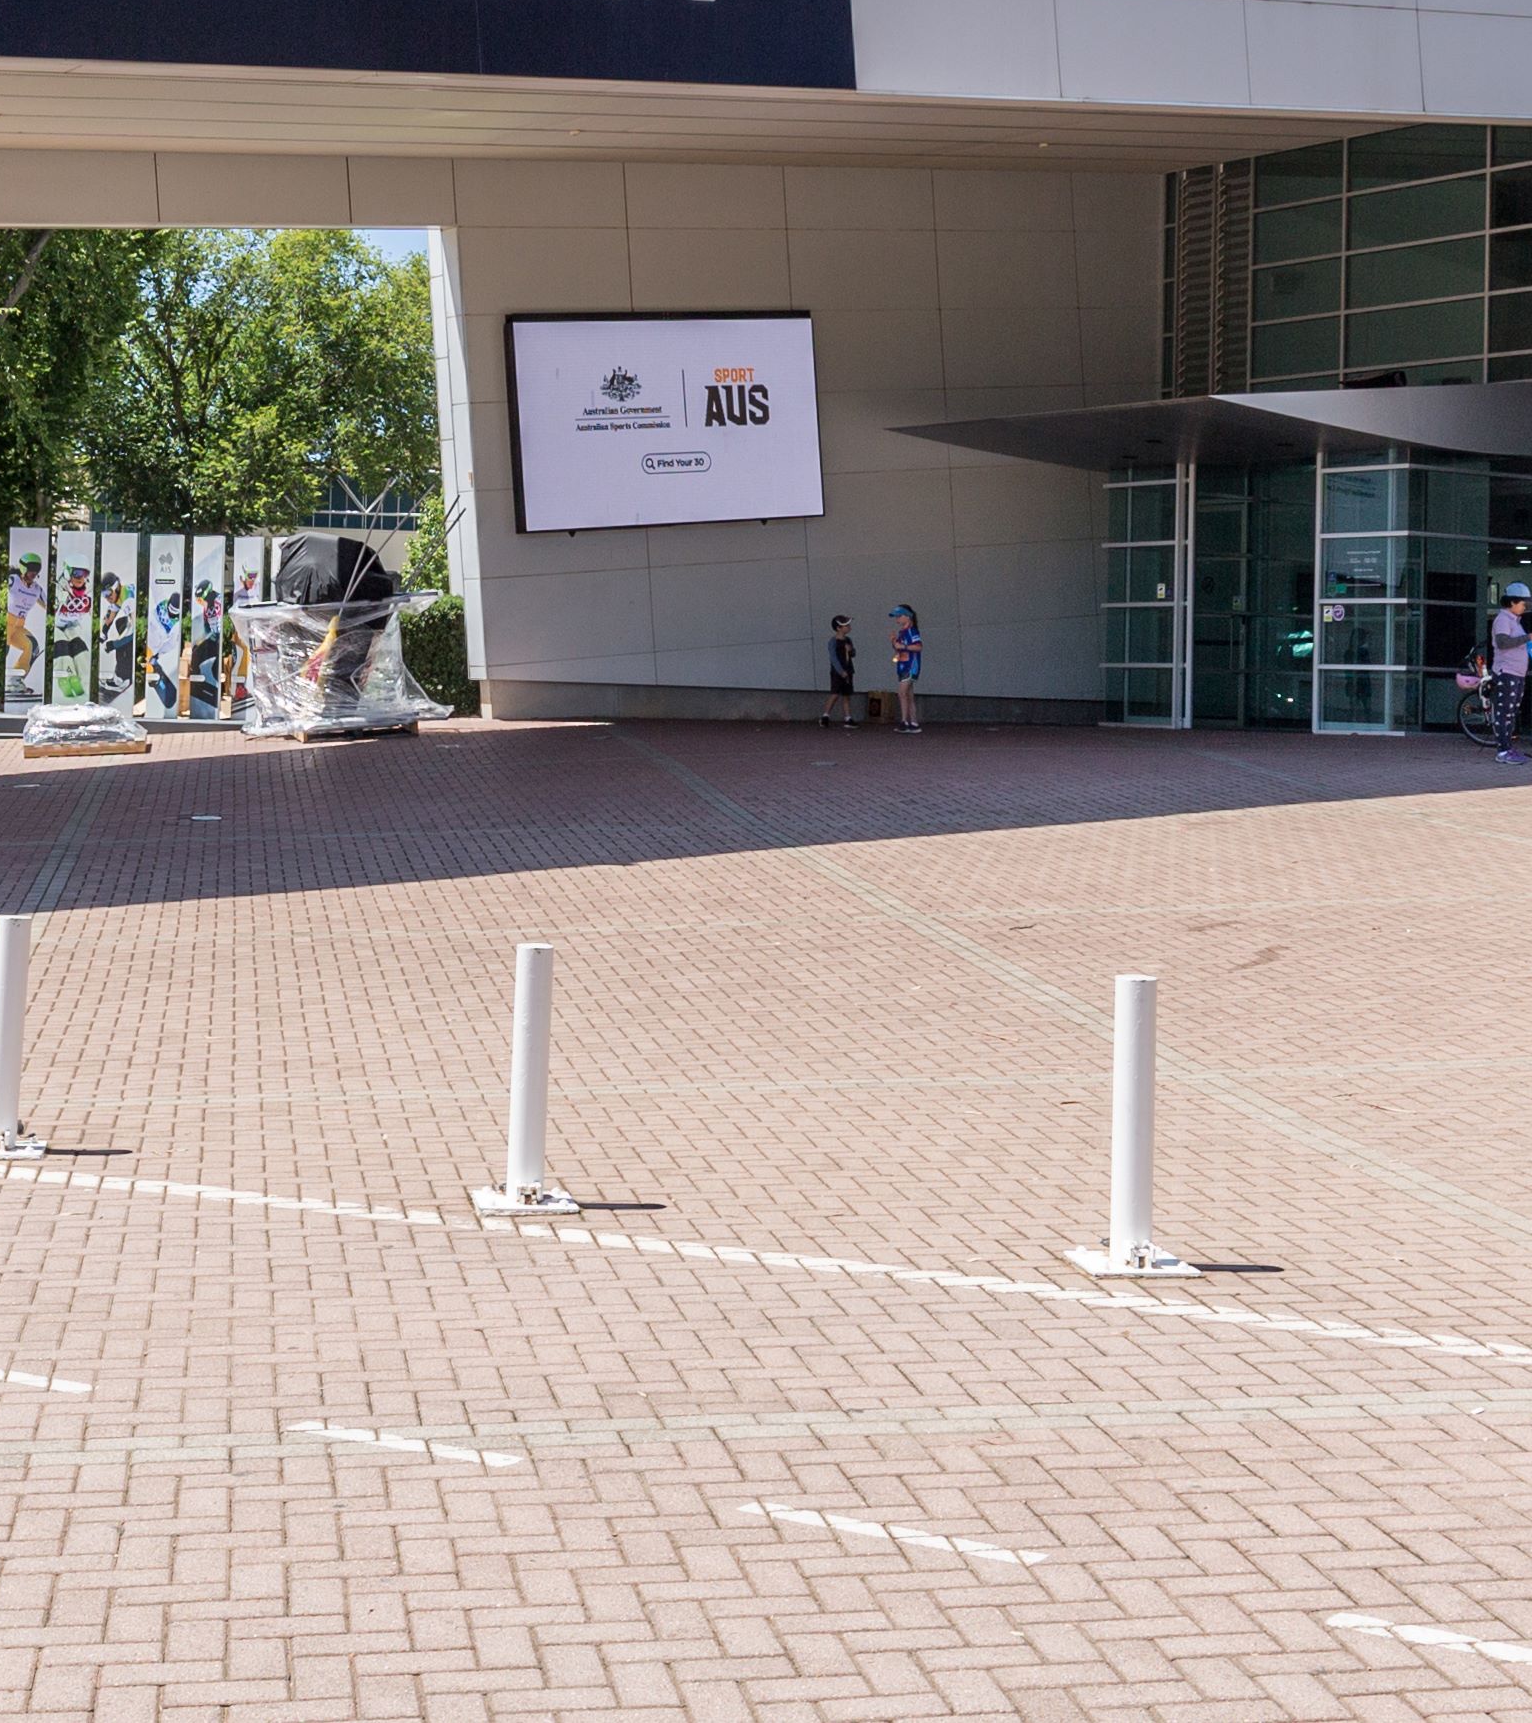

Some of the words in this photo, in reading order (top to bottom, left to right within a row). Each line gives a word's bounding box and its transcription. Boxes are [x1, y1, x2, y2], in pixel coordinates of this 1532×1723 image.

[714, 368, 754, 383] SPORT
[583, 407, 618, 415] Australian
[620, 405, 662, 414] Government
[704, 384, 770, 427] AUS
[610, 422, 631, 431] Sports
[633, 421, 670, 429] Commission
[657, 459, 674, 467] Find
[676, 458, 692, 466] Your
[694, 457, 704, 466] 30
